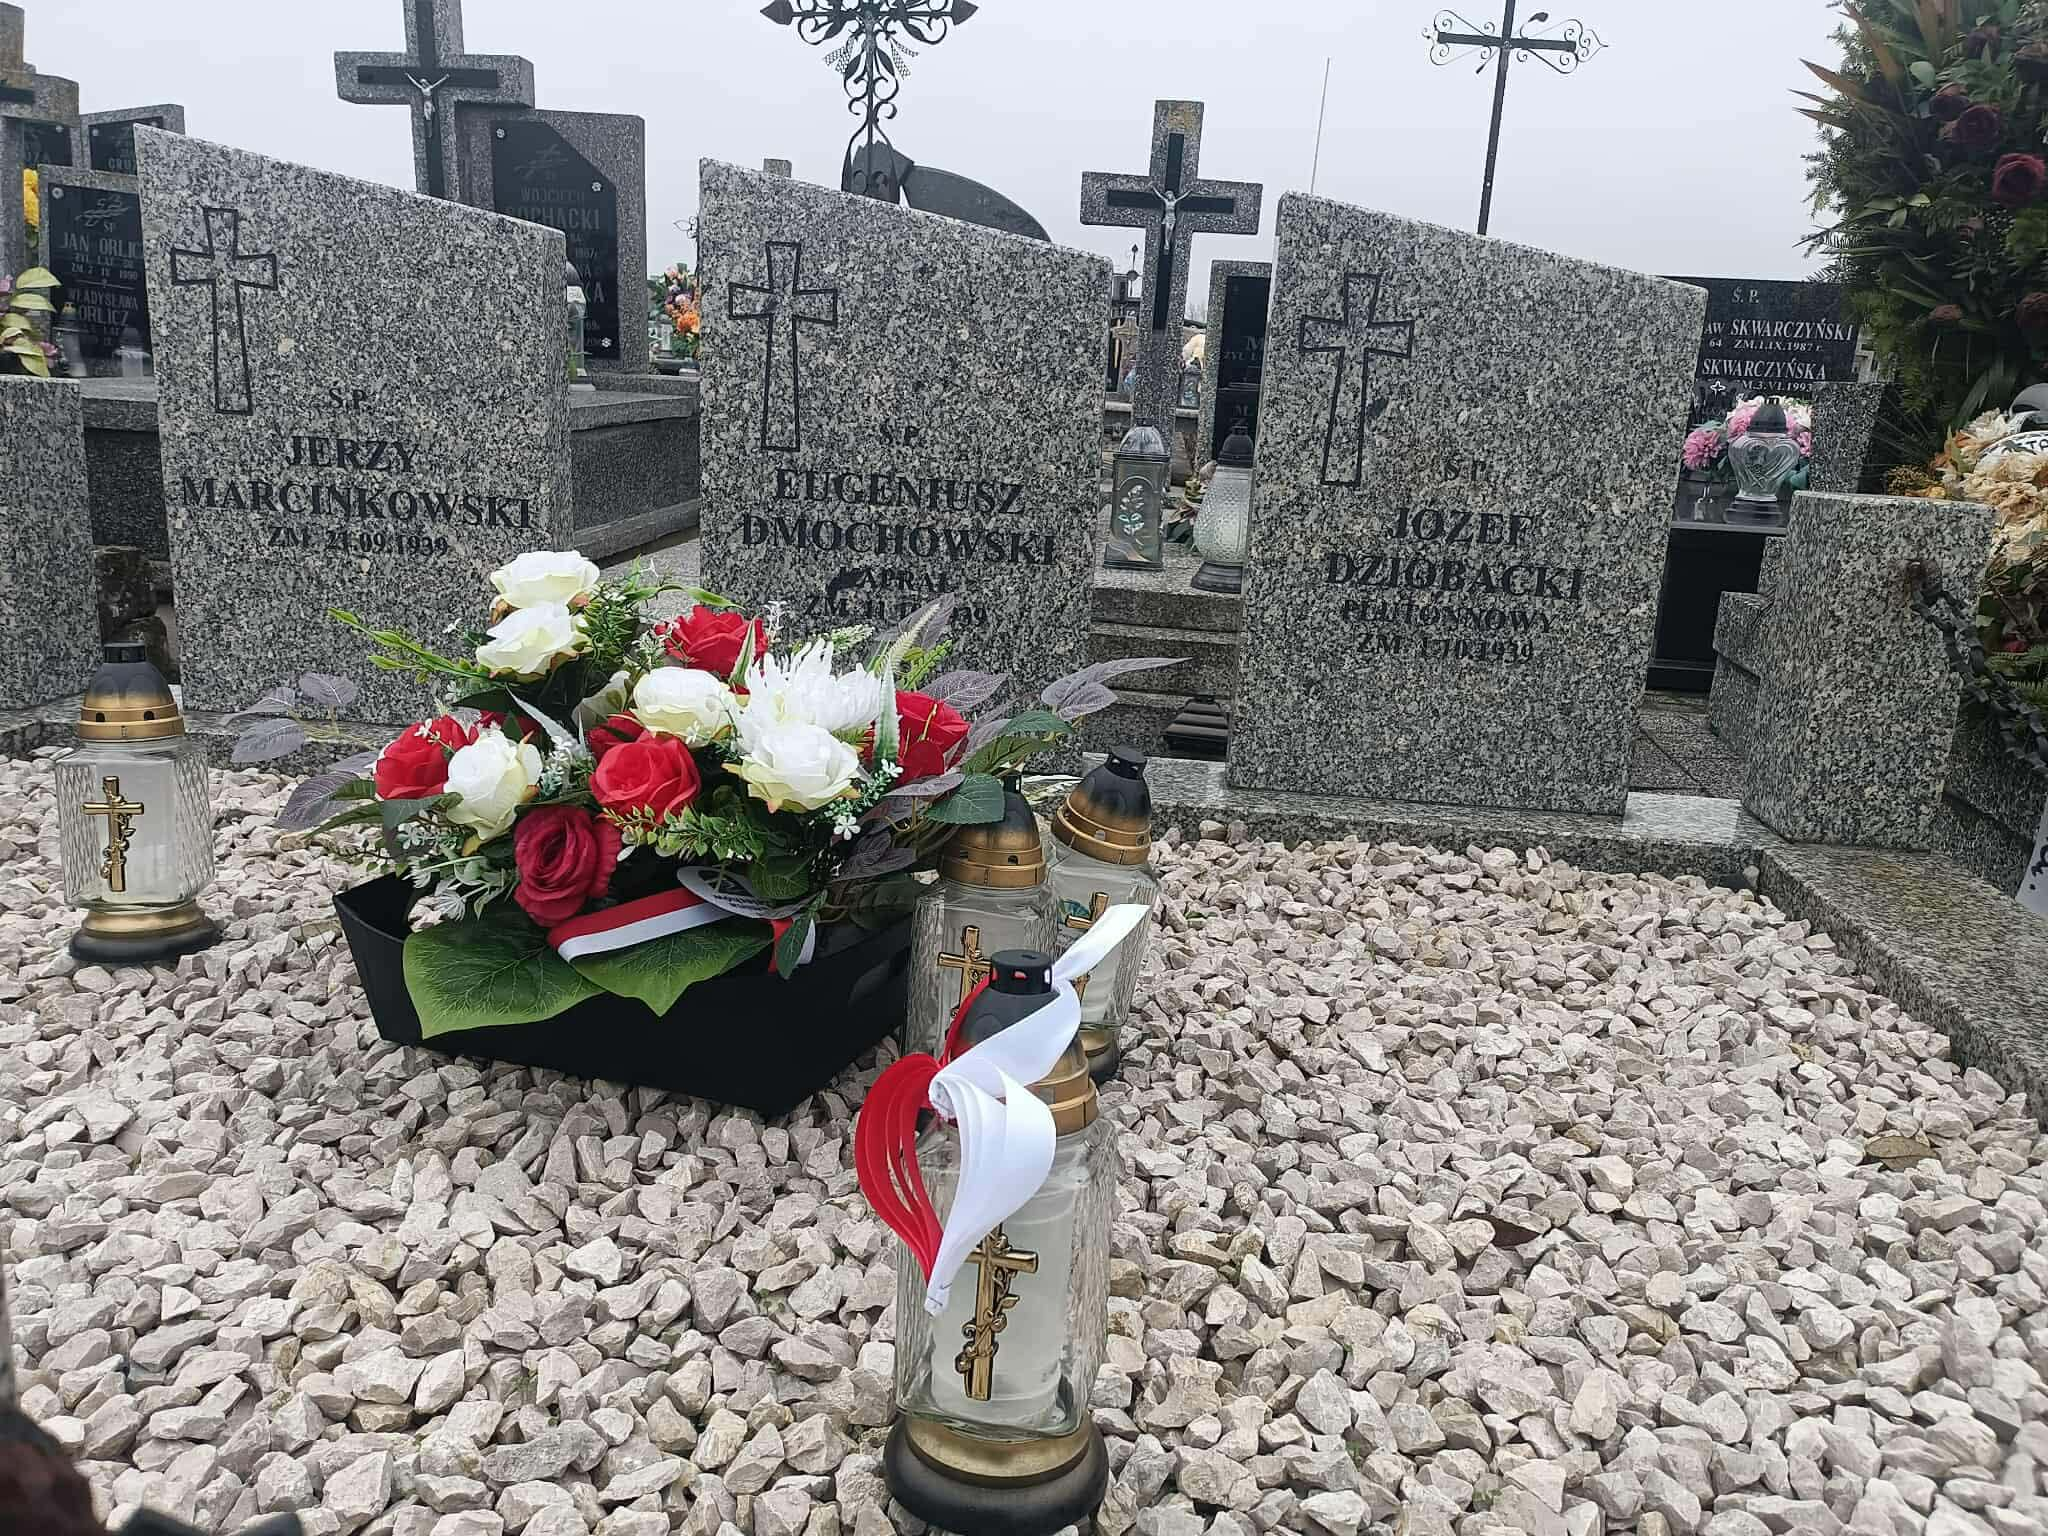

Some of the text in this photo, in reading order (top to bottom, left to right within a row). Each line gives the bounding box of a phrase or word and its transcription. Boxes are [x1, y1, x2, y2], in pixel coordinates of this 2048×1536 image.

[100, 238, 144, 259] ORLIC
[1731, 318, 1853, 341] SKWARCZYŃSKI
[1702, 357, 1827, 380] SKWARCZYŃSKA
[290, 436, 419, 472] JERZY
[182, 478, 533, 529] MARCINKOWSKI
[775, 468, 1026, 515] EUGENIUSZ
[742, 512, 1056, 566] DMOCHOWSKI
